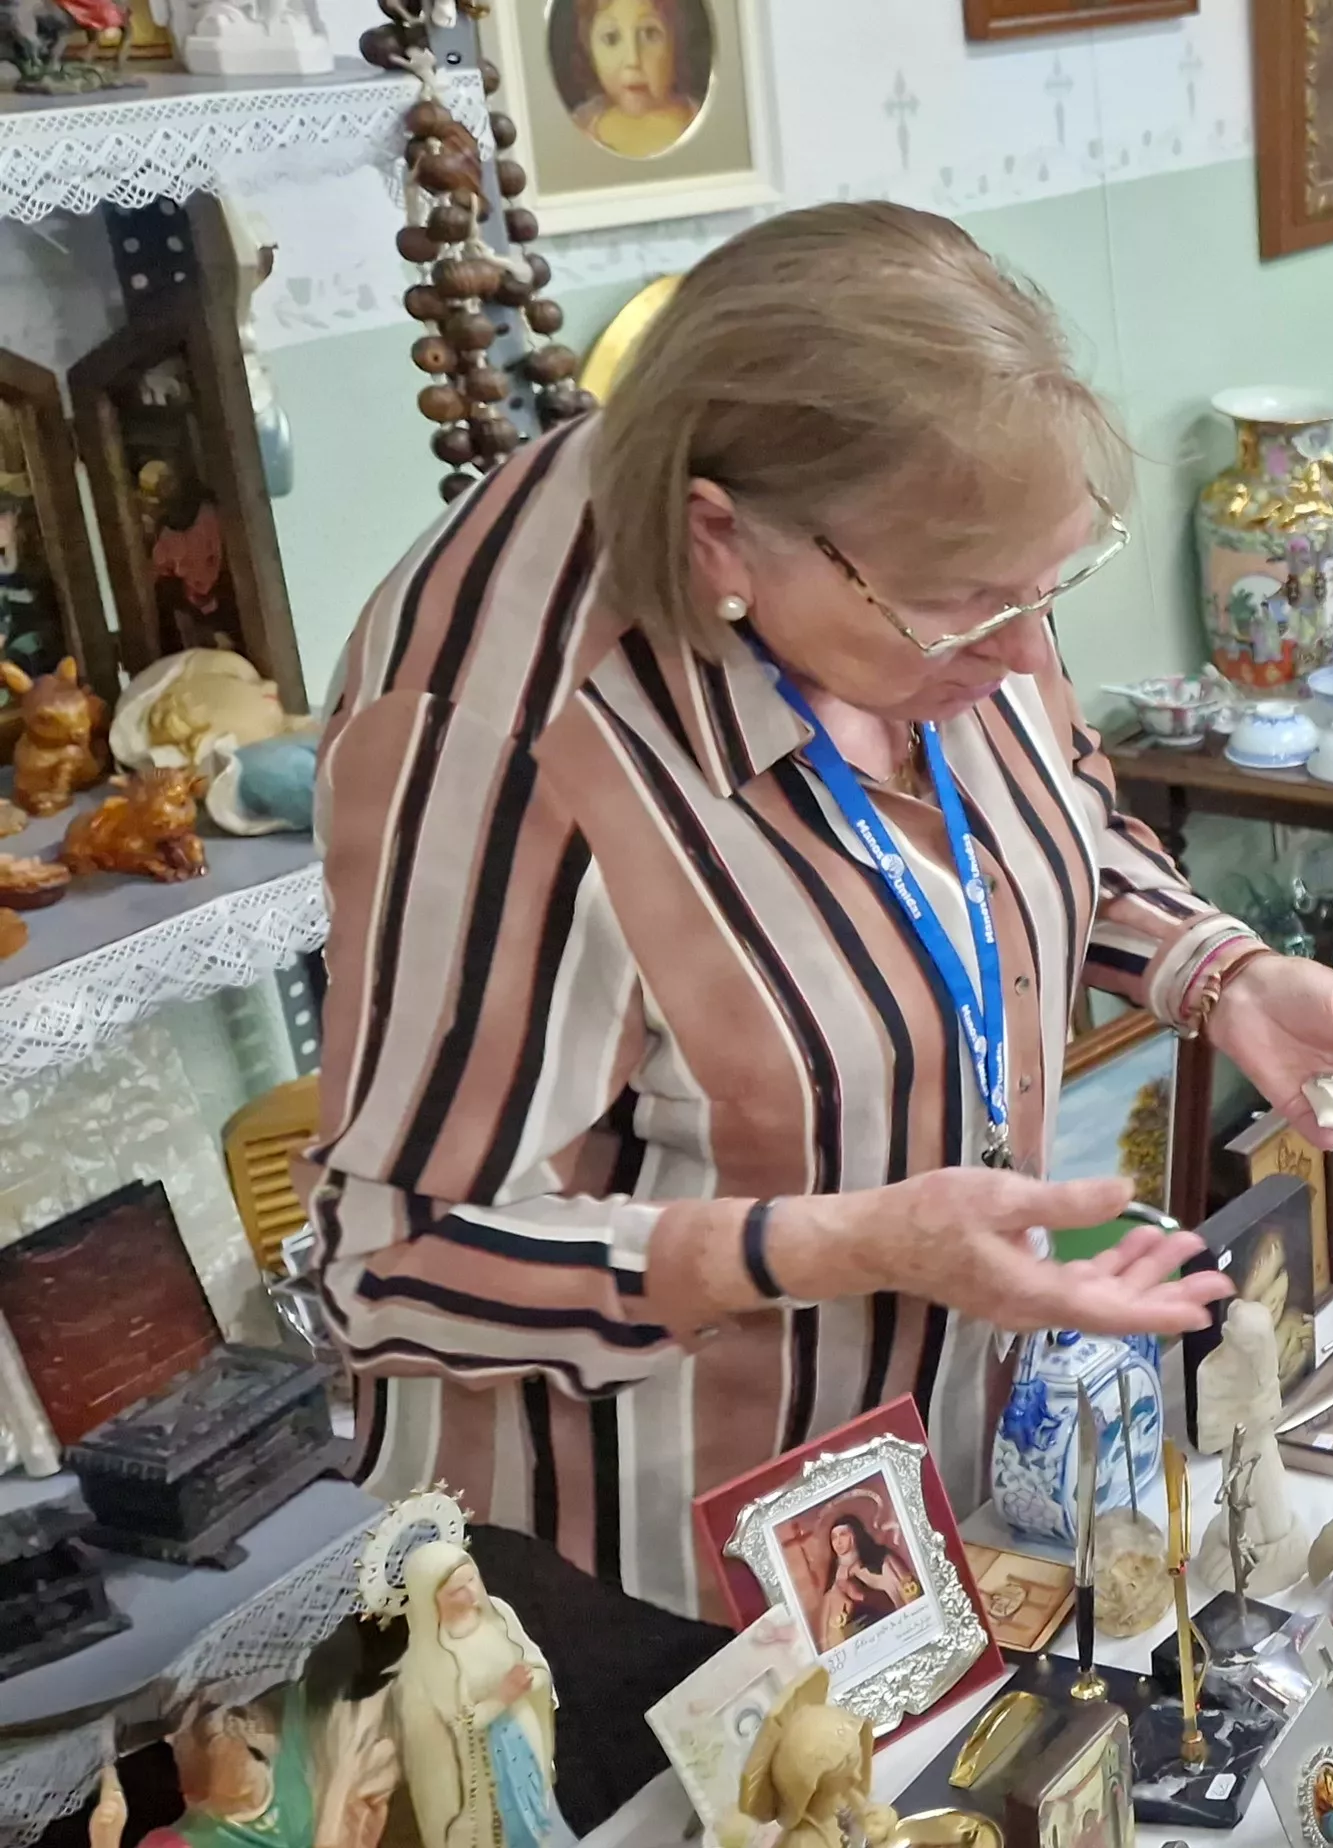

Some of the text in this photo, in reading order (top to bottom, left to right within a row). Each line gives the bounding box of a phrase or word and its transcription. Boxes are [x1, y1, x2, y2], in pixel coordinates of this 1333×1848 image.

[856, 819, 922, 920] Manos Unidas
[979, 901, 995, 944] Manos
